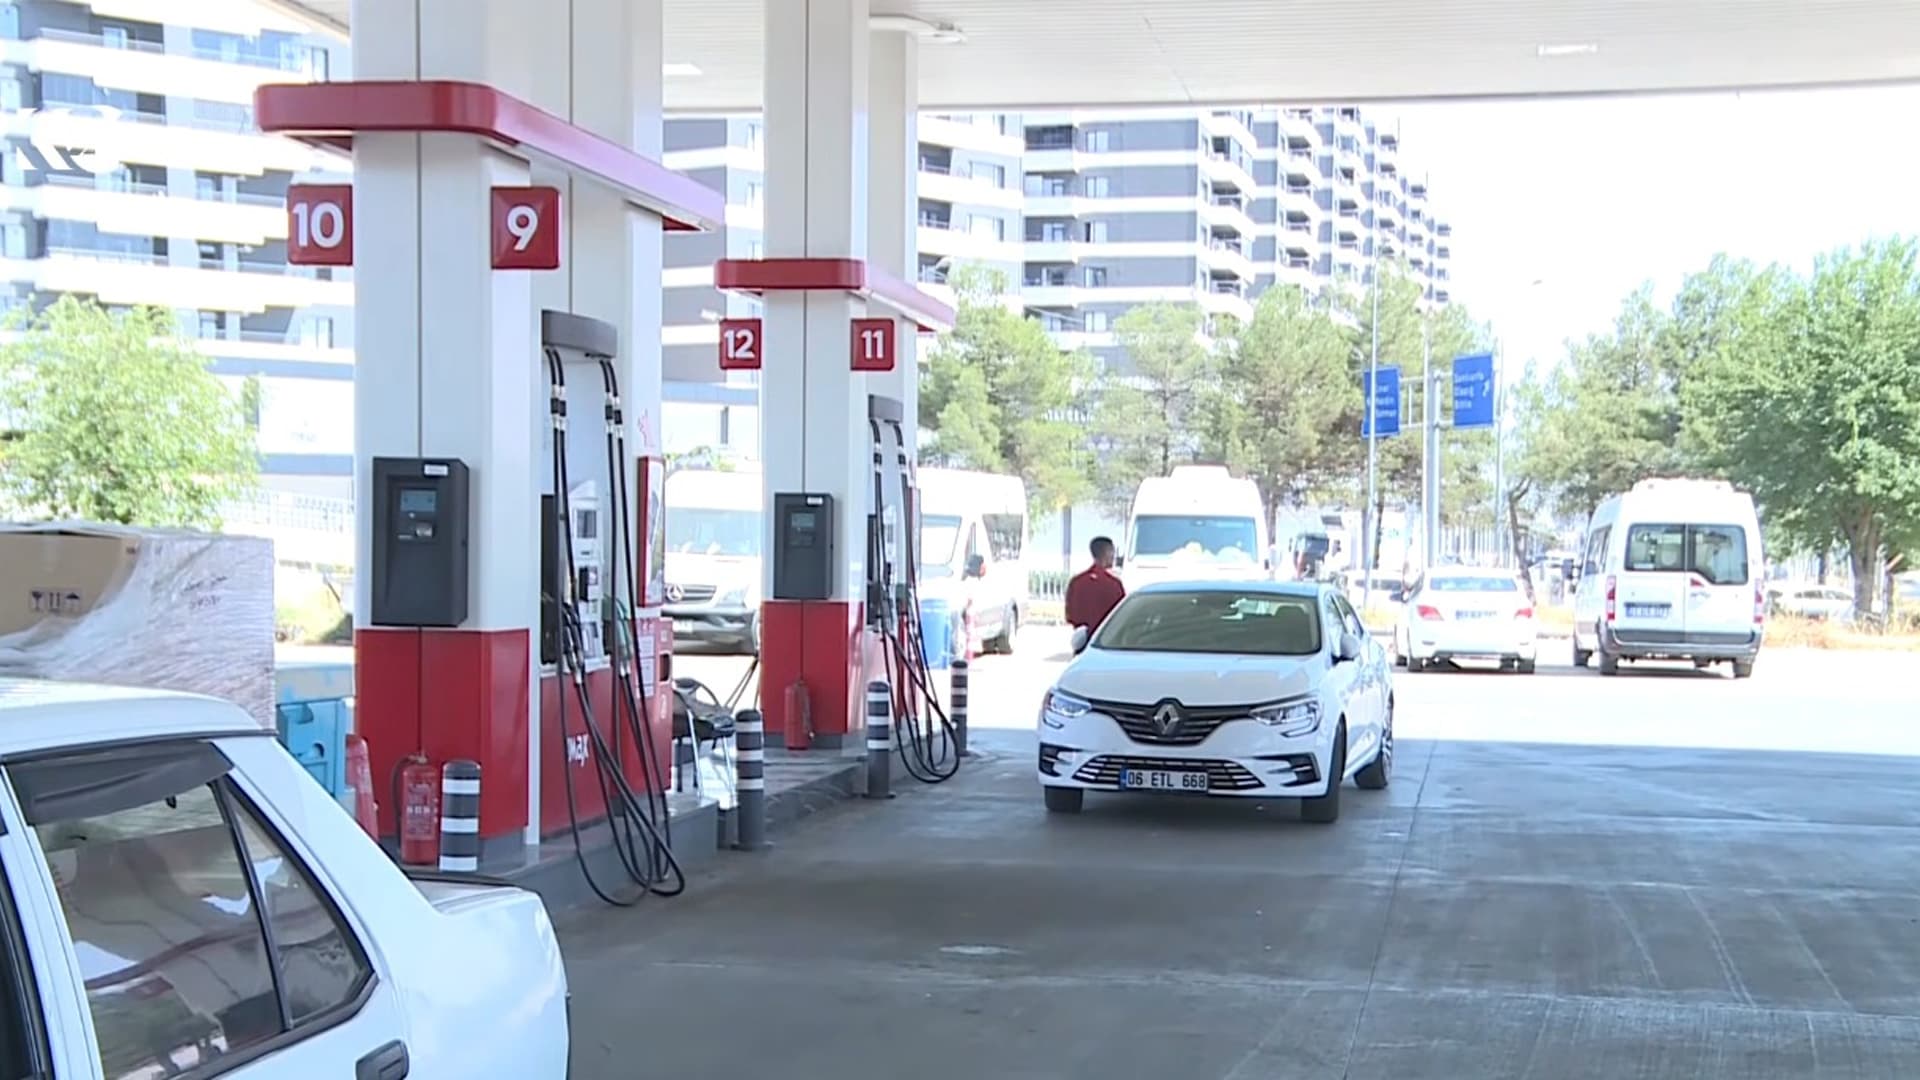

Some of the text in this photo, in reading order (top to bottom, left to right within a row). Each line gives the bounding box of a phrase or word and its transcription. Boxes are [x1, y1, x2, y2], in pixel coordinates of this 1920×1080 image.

[292, 202, 344, 249] 10
[507, 205, 538, 251] 9
[724, 329, 756, 359] 12
[860, 329, 885, 360] 11
[1127, 771, 1144, 786] 06
[1151, 772, 1175, 788] ETL
